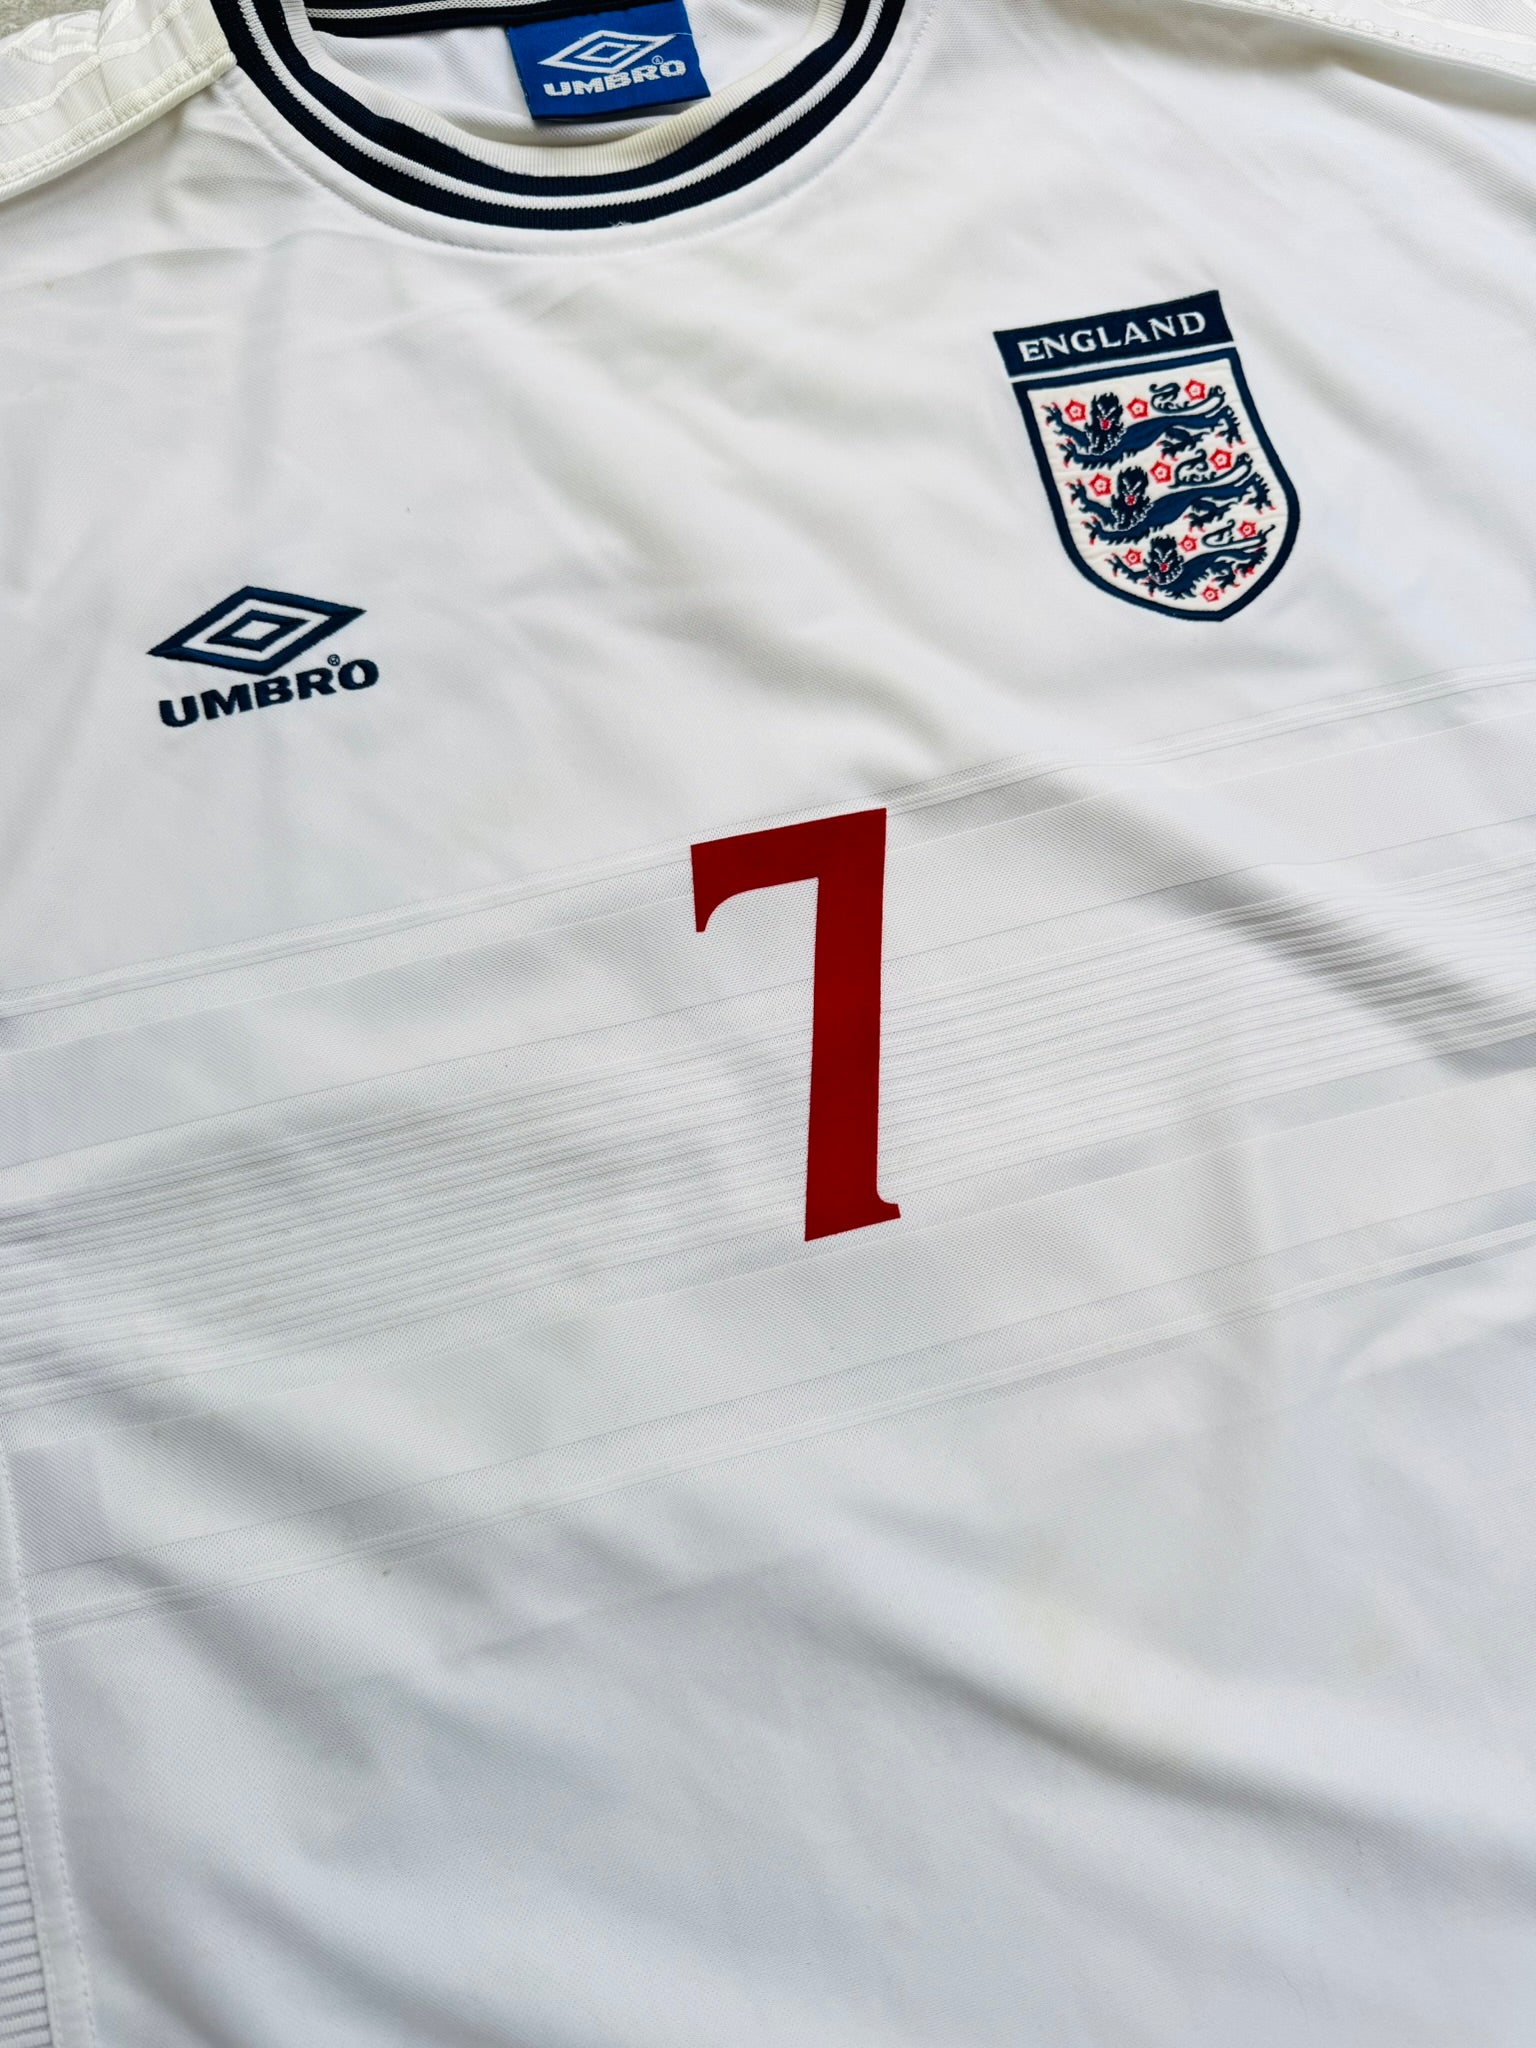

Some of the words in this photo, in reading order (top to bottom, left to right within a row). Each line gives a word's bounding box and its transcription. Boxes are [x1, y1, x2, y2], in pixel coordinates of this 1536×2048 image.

[543, 59, 687, 97] UMBRO
[1017, 310, 1206, 363] ENGLAND
[158, 658, 380, 728] UMBRO
[691, 809, 900, 1241] 7
